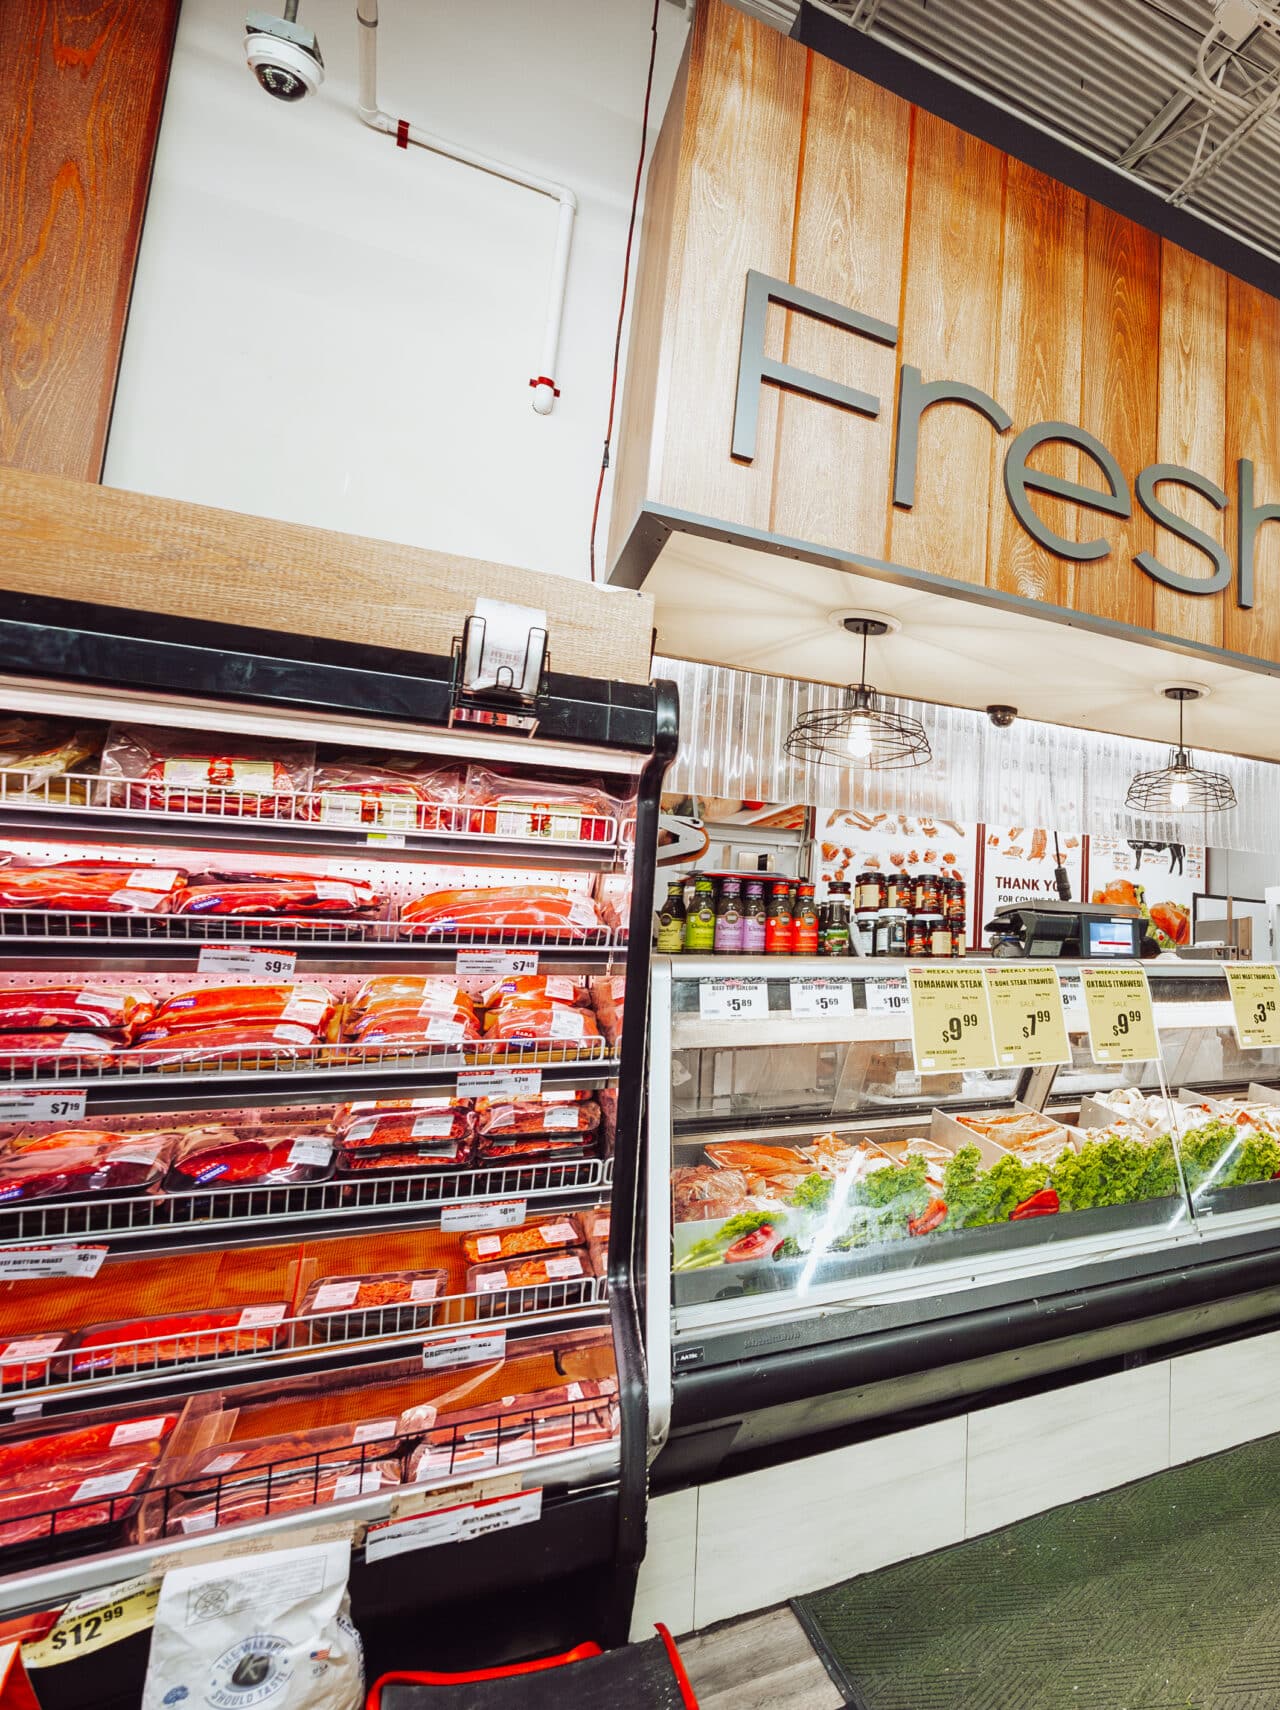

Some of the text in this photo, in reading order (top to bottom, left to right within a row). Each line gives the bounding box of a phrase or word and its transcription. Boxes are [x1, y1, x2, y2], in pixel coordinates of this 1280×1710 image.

[995, 876, 1058, 892] THANK YO
[913, 979, 984, 989] TOMAHAWK STEAK
[1022, 1010, 1051, 1038] $799
[1112, 1010, 1141, 1037] $999
[1253, 1001, 1276, 1024] $349
[942, 1014, 978, 1043] $999
[51, 1102, 80, 1115] $719
[52, 1606, 124, 1650] $1299
[212, 1690, 254, 1706] SHOULD
